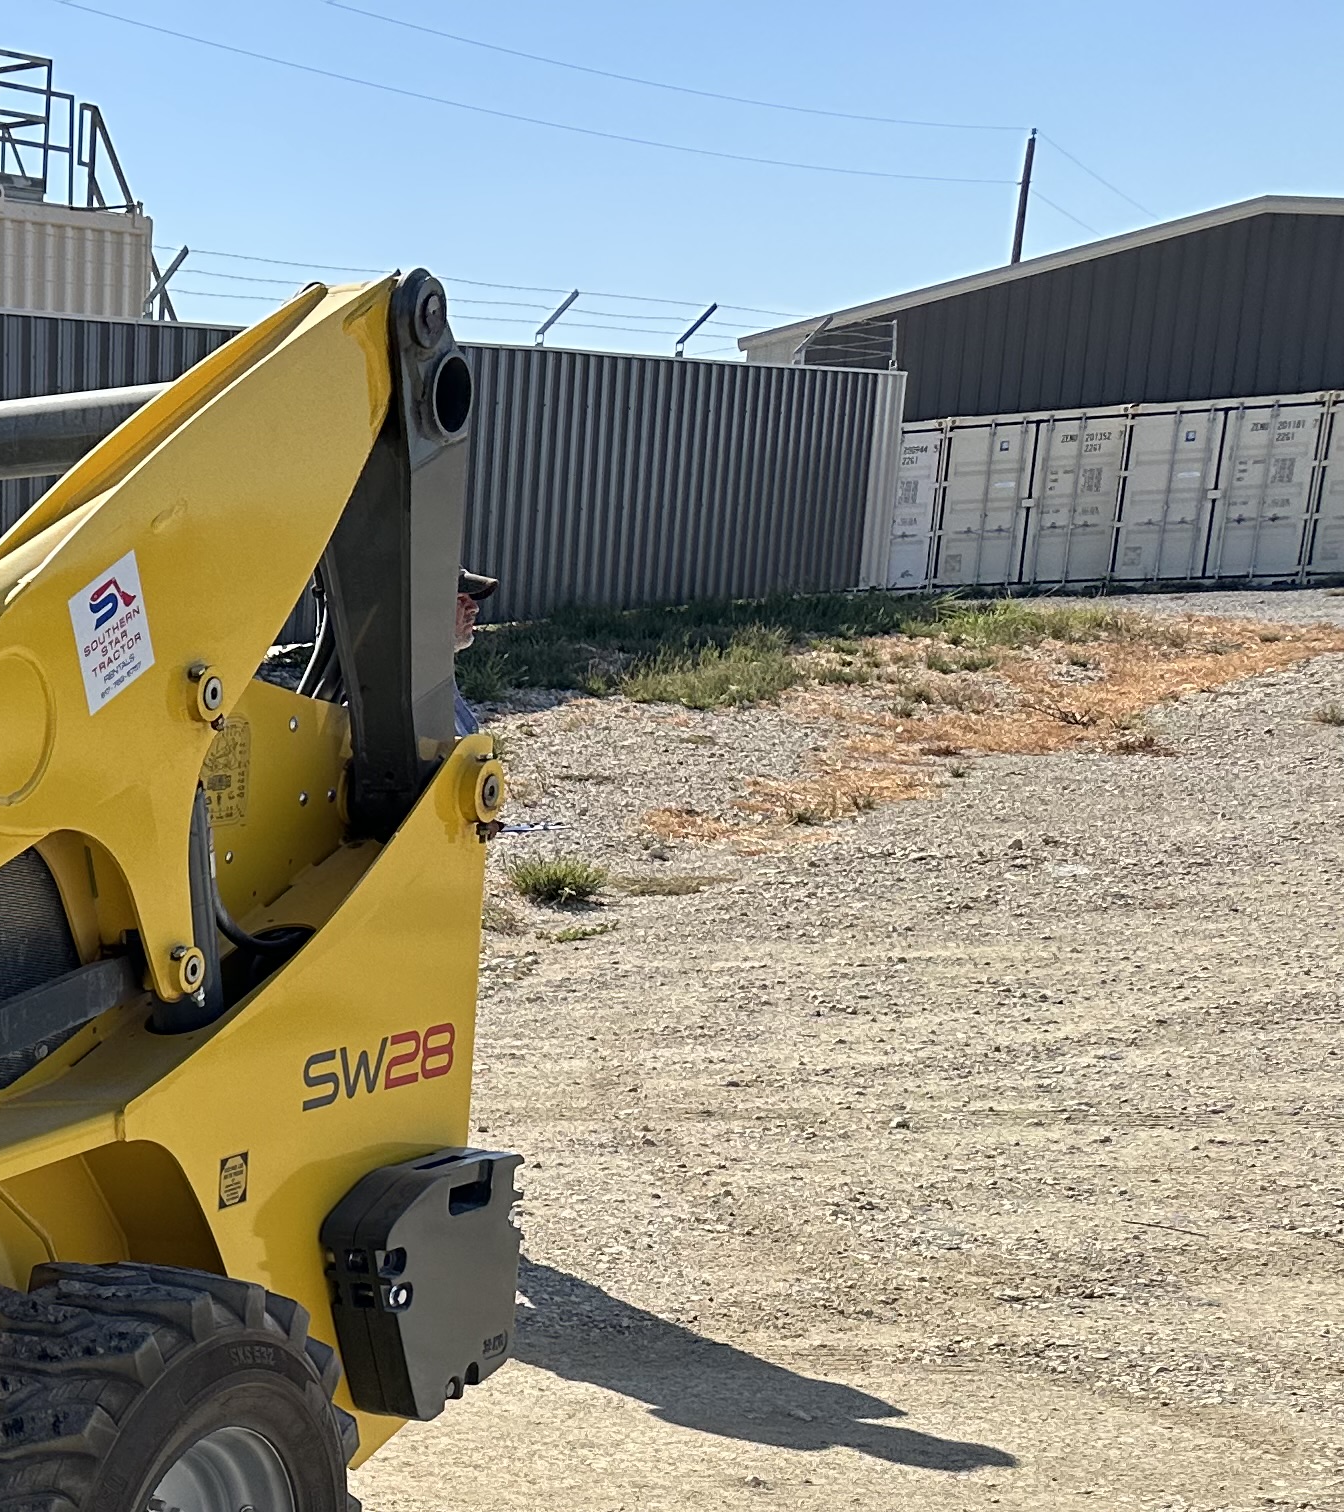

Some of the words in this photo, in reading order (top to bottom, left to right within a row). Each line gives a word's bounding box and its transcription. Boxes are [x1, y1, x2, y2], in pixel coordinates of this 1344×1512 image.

[83, 605, 141, 658] SOUTHERN
[101, 629, 128, 658] STAR
[91, 632, 142, 678] TRACTOR
[103, 653, 135, 684] RENTALS
[302, 1022, 456, 1112] SW28
